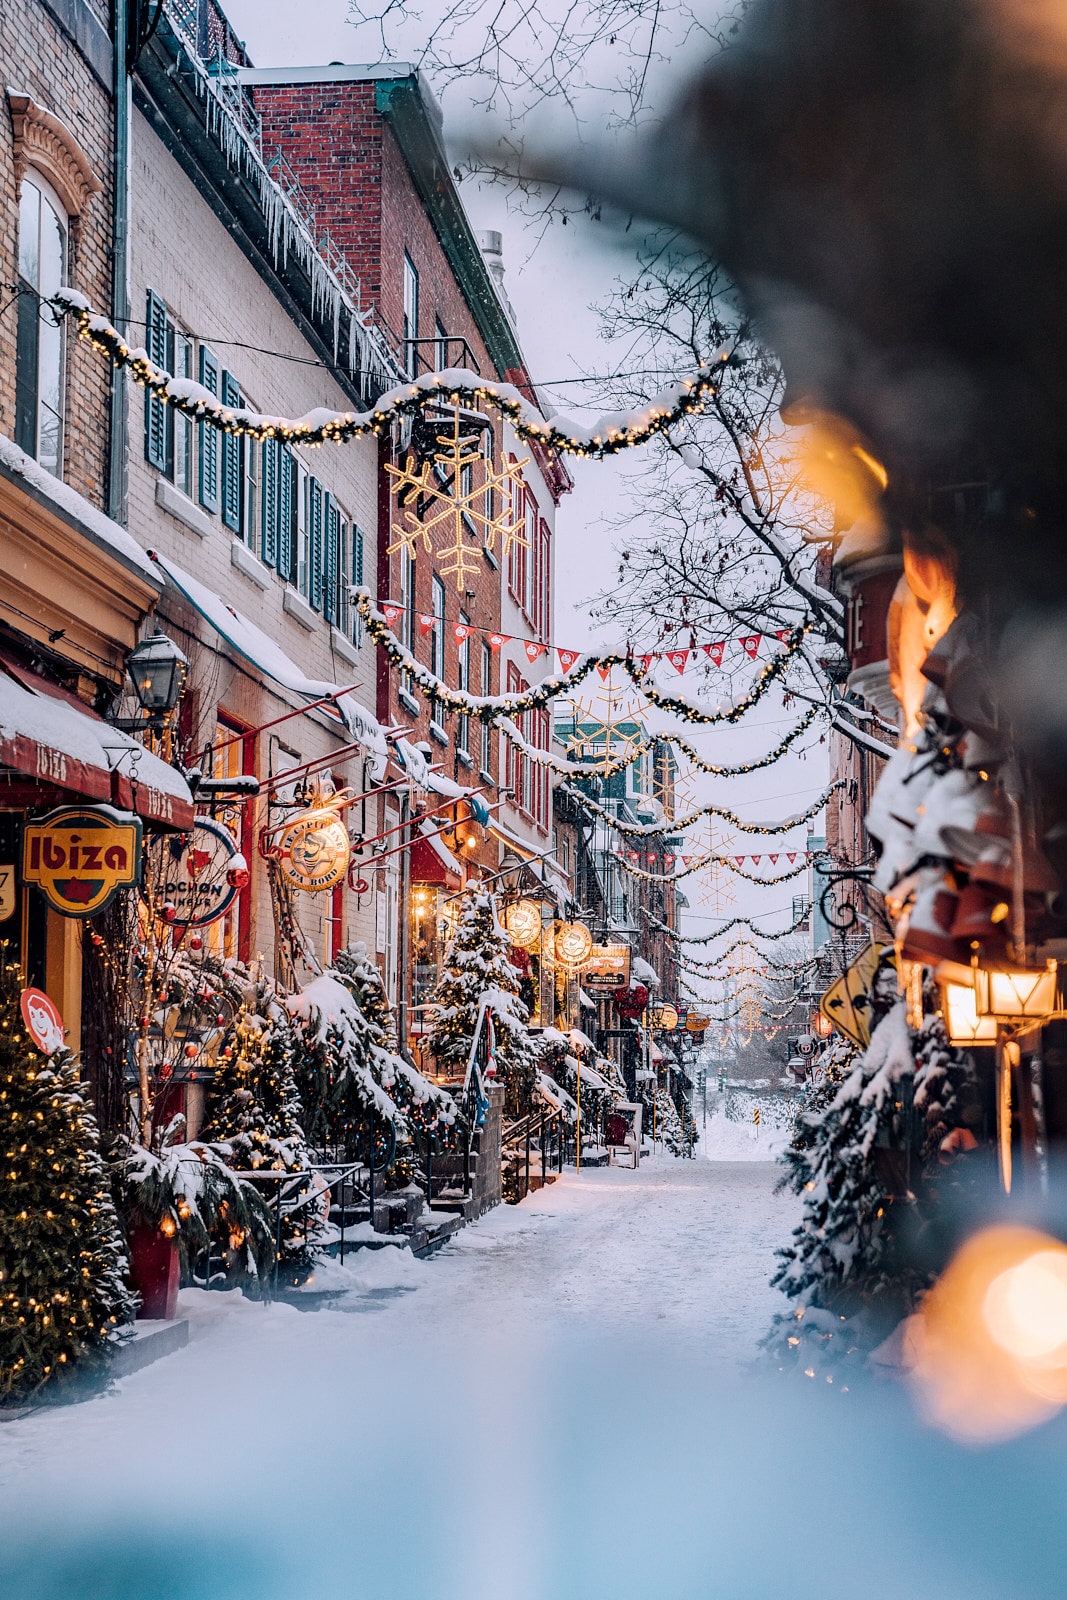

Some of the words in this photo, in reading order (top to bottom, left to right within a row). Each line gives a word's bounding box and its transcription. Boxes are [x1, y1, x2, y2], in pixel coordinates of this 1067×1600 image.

[284, 834, 294, 848] LE
[30, 834, 127, 870] Ibiza
[310, 869, 338, 886] BORD
[155, 881, 223, 897] COCHON
